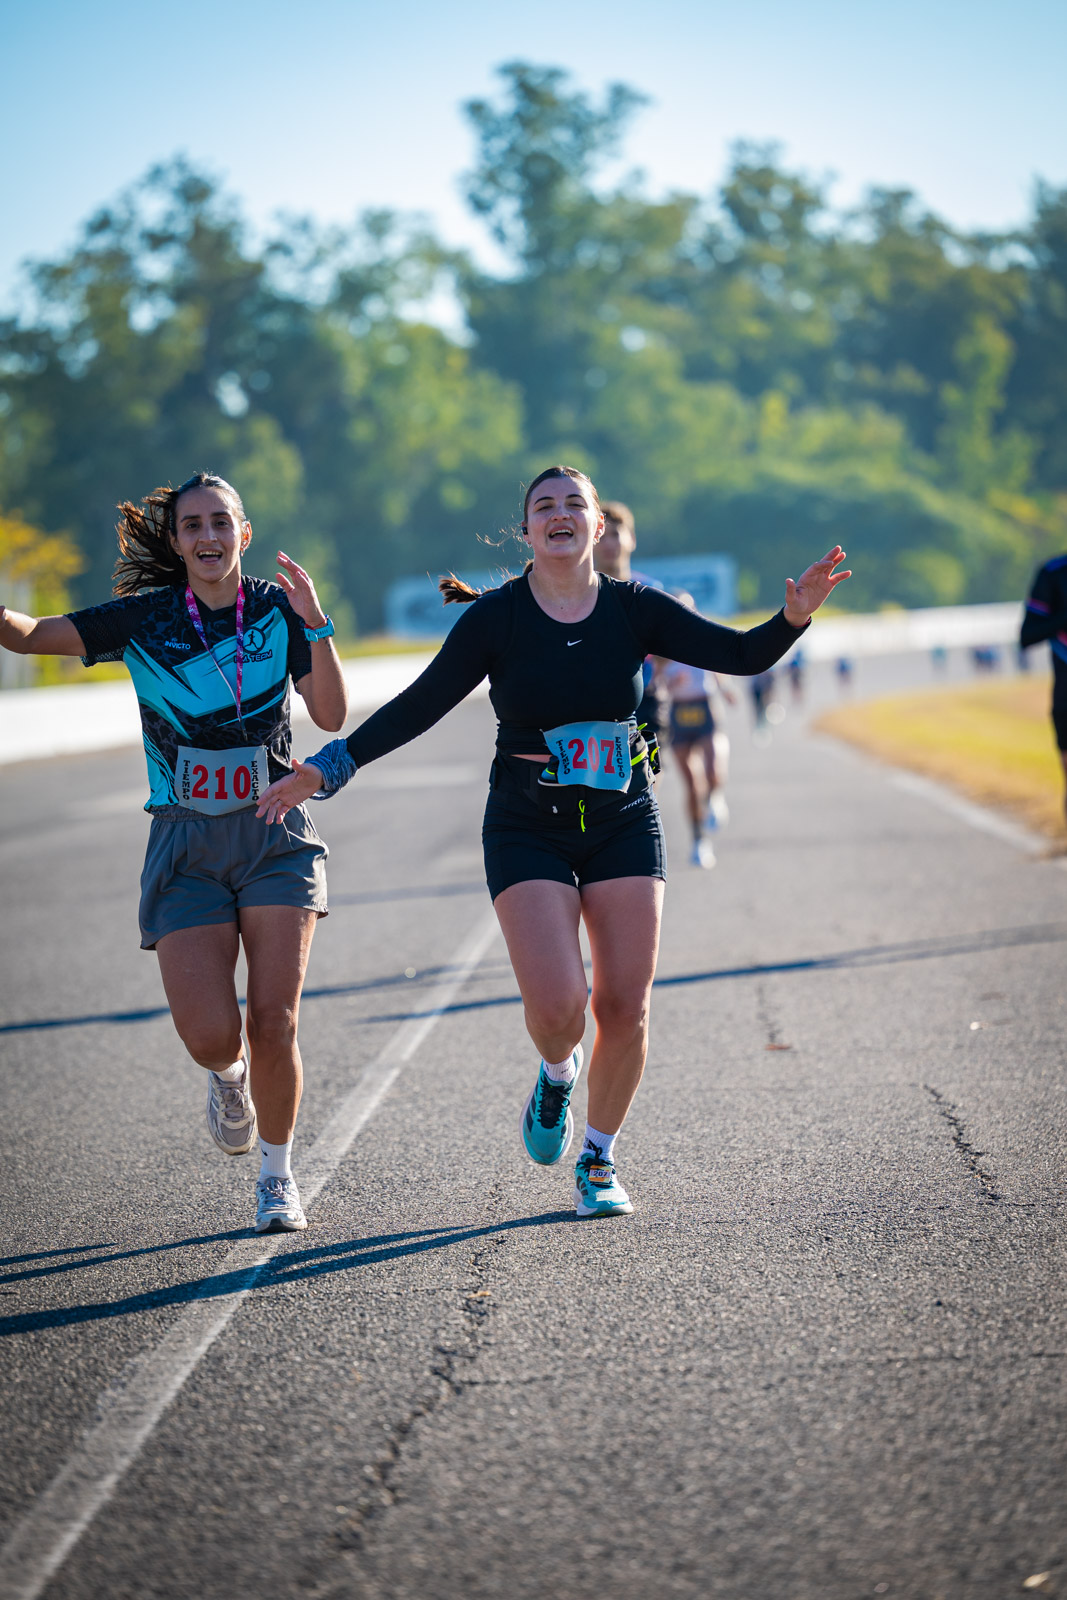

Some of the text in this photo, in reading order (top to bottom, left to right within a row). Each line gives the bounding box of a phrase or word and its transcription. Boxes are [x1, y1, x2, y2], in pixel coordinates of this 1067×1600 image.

[164, 640, 191, 650] INVICTO
[250, 649, 273, 662] TEAM
[556, 740, 570, 774] TIEMPO
[568, 737, 615, 774] 207
[615, 737, 625, 778] EXACTO
[182, 760, 190, 800] TIEMPO
[192, 765, 251, 799] 210
[251, 761, 259, 801] EXACTO
[593, 1170, 608, 1178] 207
